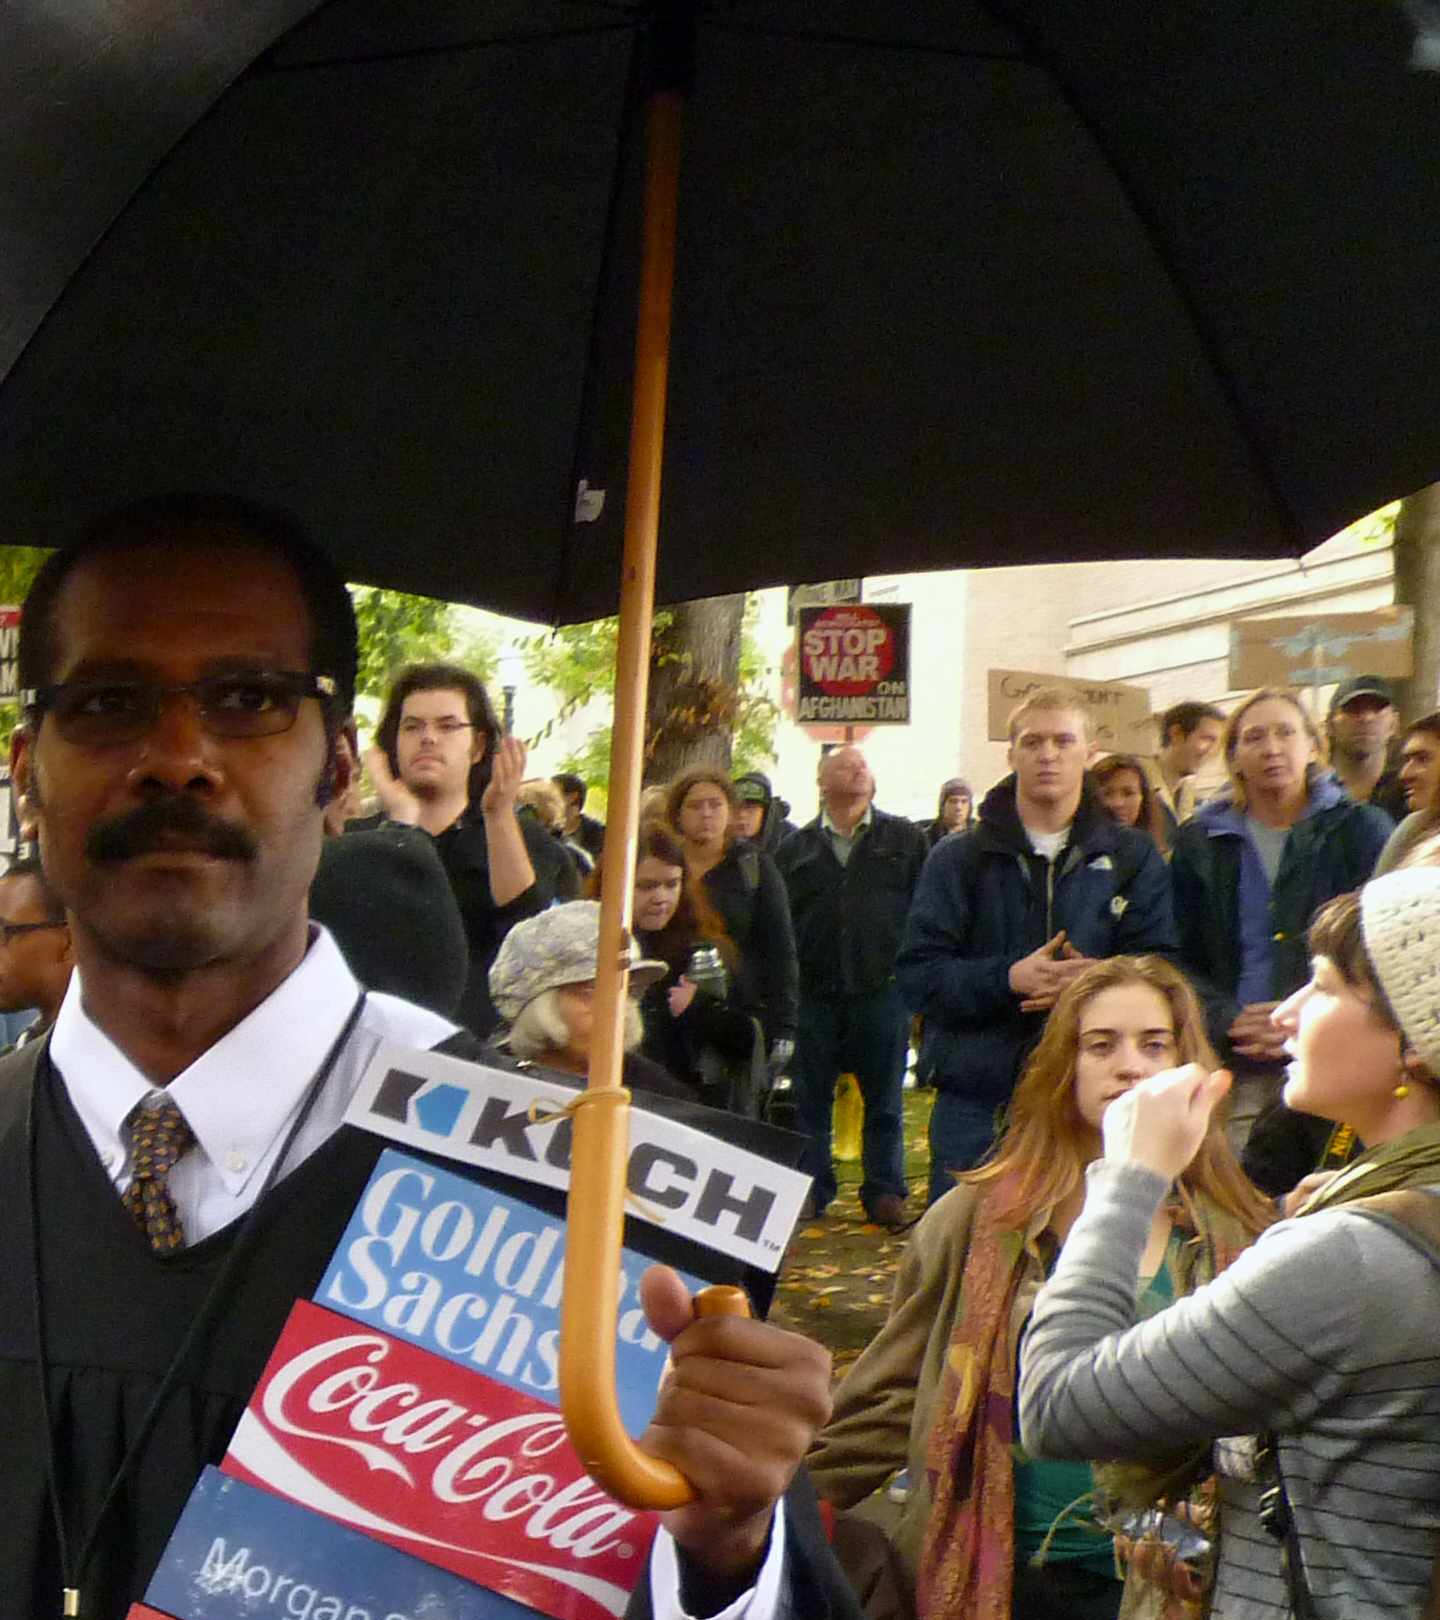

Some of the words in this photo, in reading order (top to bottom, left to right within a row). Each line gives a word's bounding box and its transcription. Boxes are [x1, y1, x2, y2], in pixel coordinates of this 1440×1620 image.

[803, 628, 888, 657] STOP
[808, 655, 881, 682] WAR
[877, 681, 906, 695] ON
[799, 696, 908, 720] AFGHANISTAN
[361, 1168, 665, 1352] Golda
[327, 1235, 561, 1391] Sachs
[262, 1333, 635, 1558] Coca-Cola
